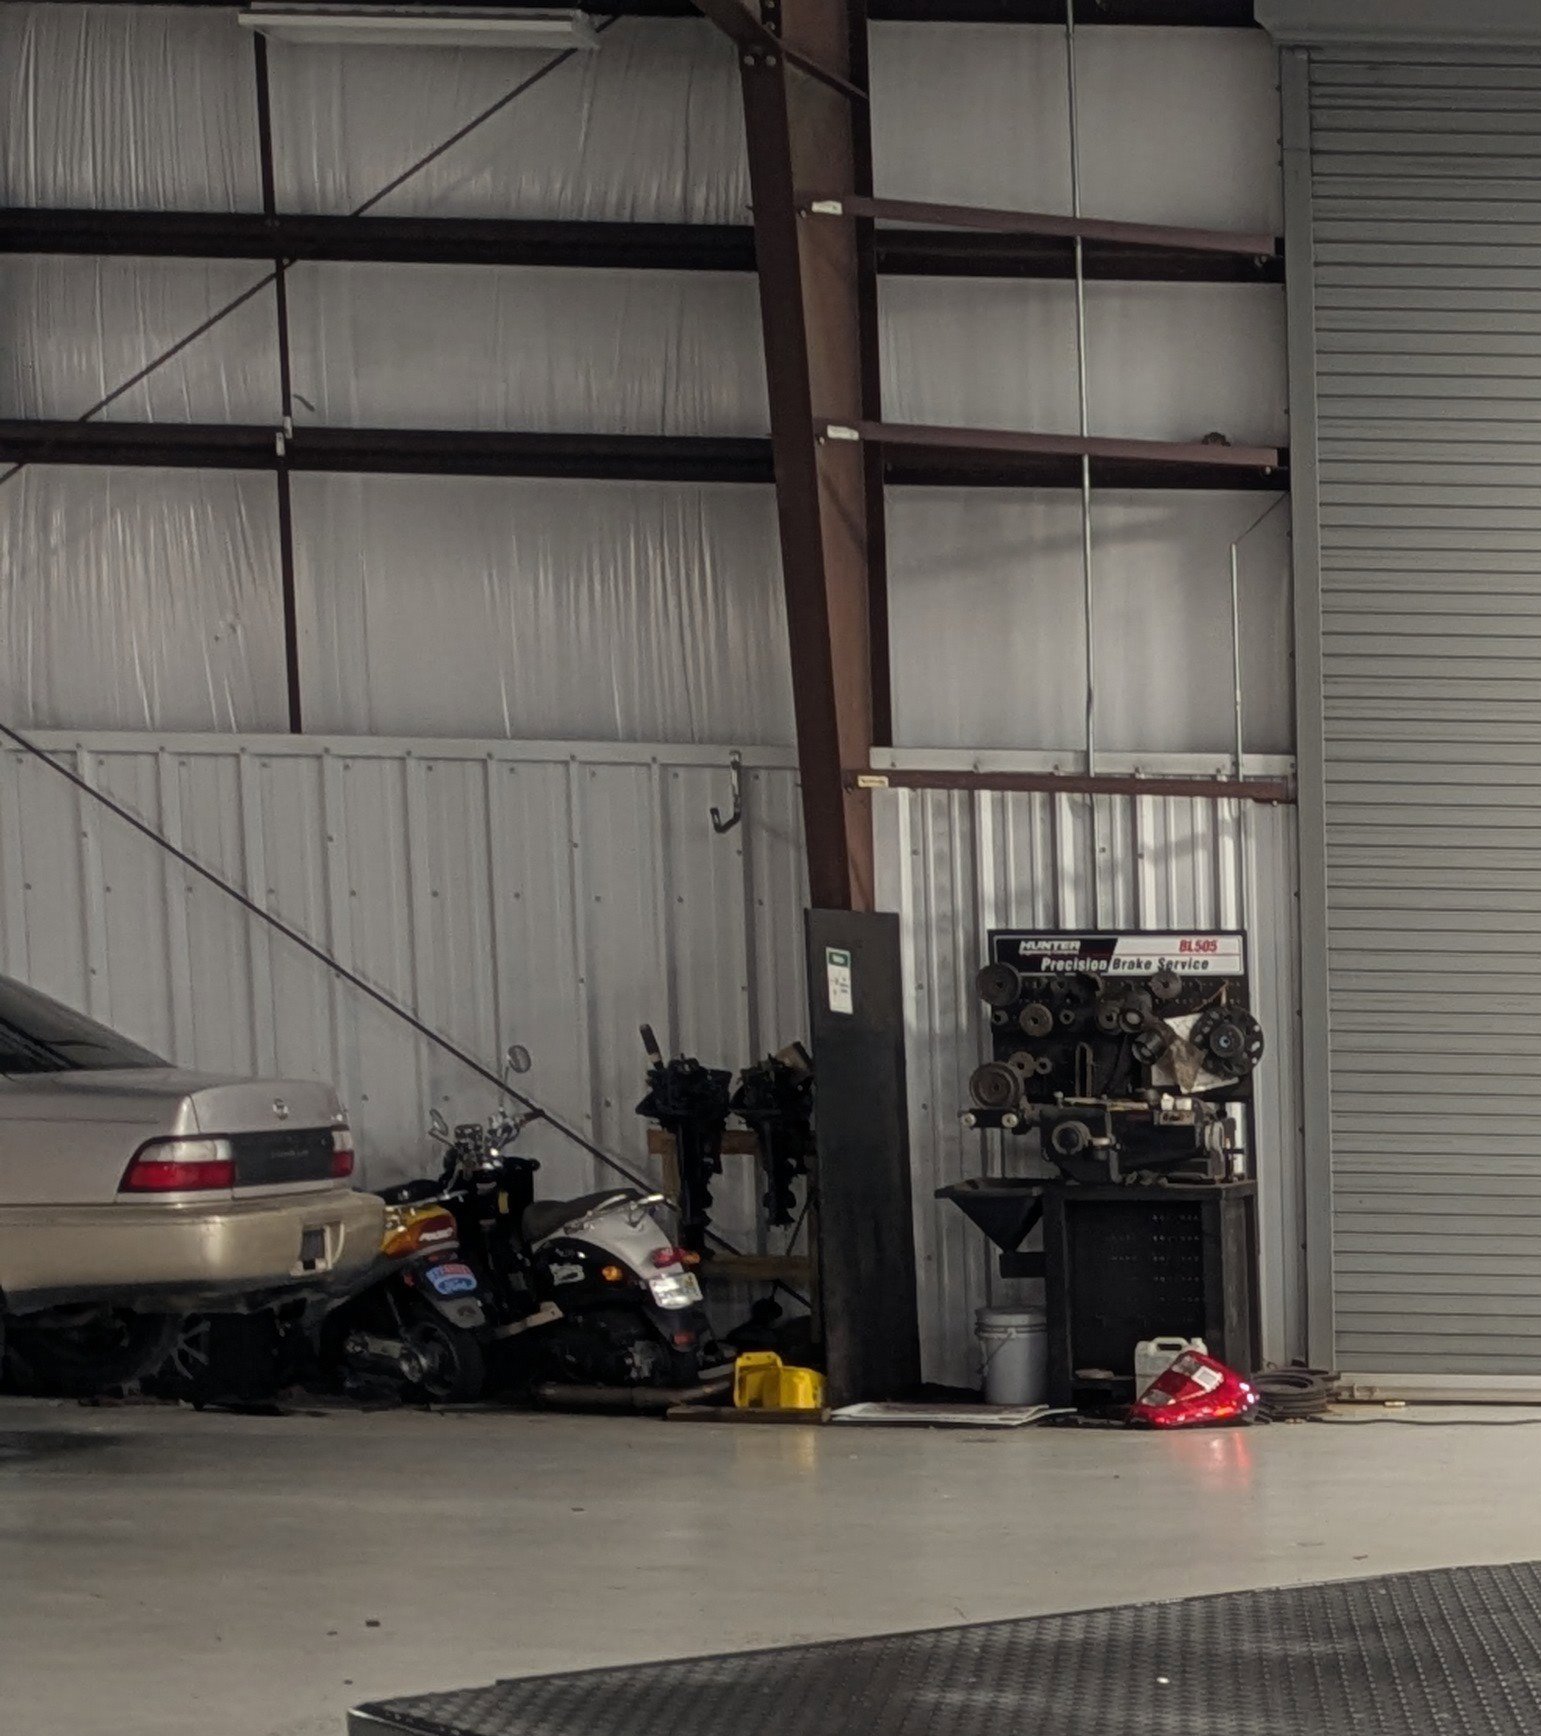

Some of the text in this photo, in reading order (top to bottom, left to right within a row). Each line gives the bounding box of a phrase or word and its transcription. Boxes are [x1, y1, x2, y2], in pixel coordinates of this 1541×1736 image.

[1019, 940, 1081, 950] HUNTER
[1179, 940, 1218, 953] BL505
[1041, 957, 1209, 972] Precision Brake Service
